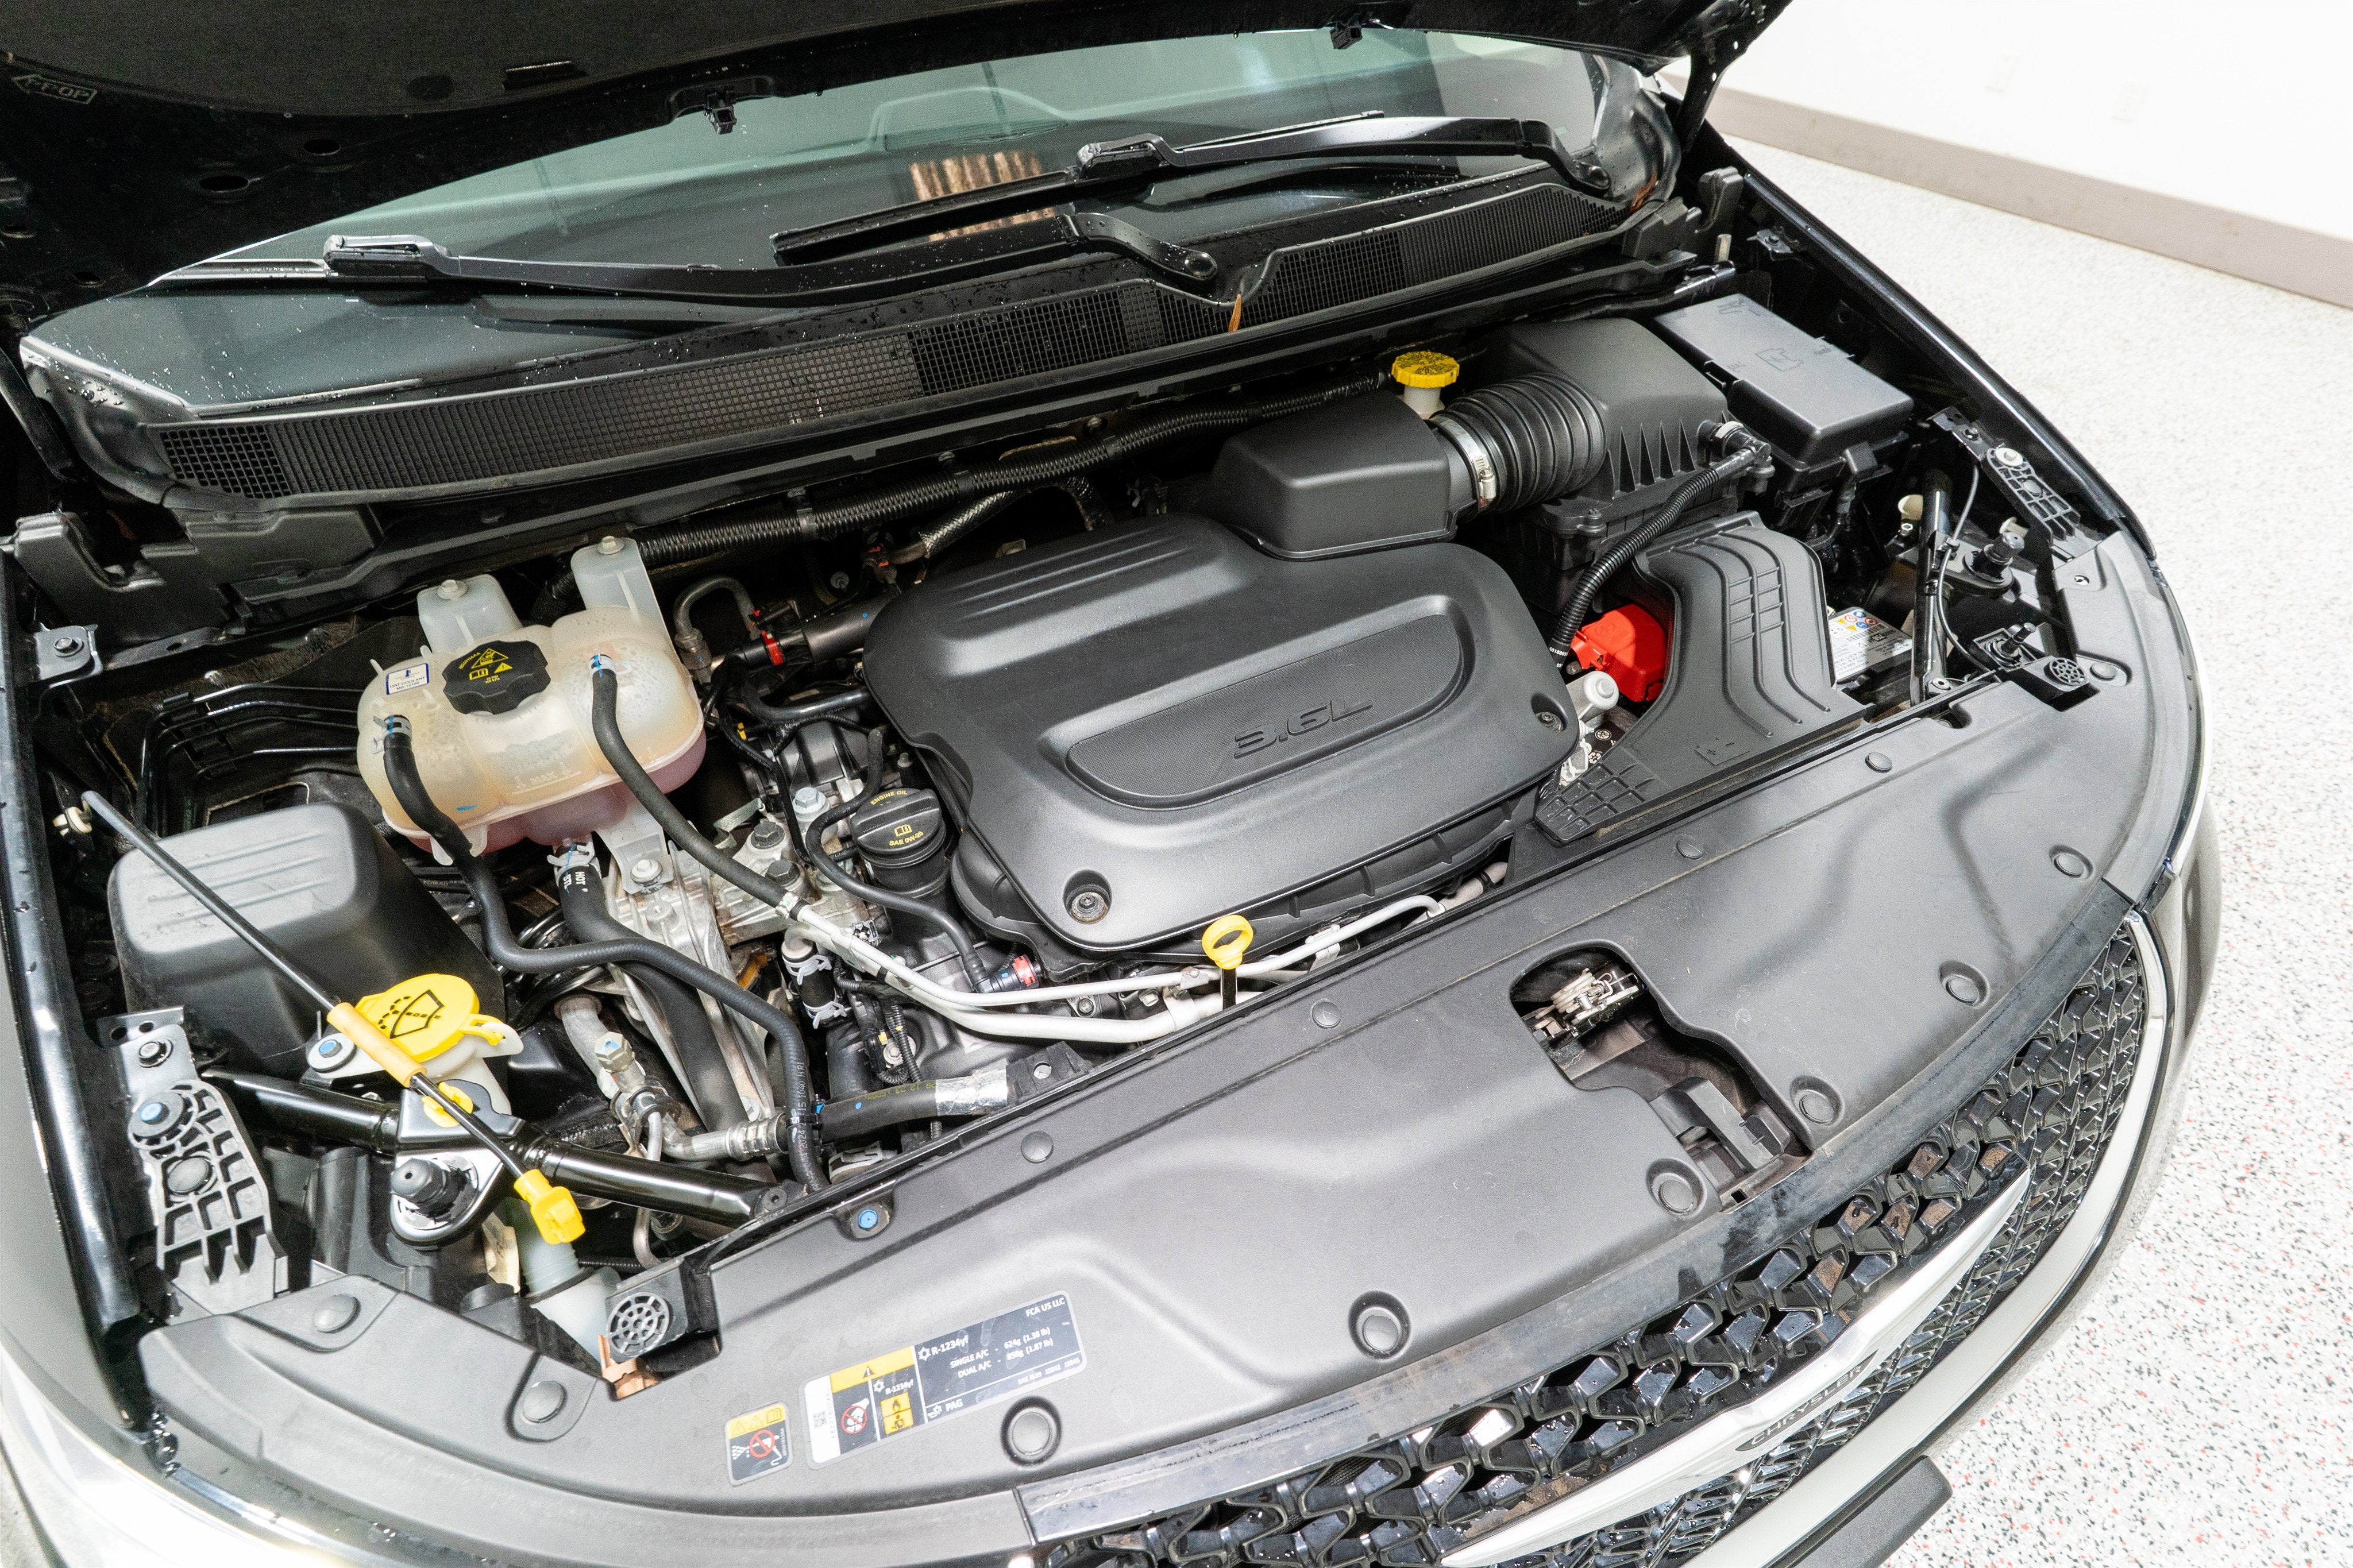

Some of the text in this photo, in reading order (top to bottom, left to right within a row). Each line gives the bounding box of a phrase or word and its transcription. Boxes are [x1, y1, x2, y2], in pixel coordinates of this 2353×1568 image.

[1233, 696, 1373, 759] 3.6L
[530, 771, 557, 785] MAX
[870, 791, 895, 805] ENGINE
[904, 831, 924, 844] 0W-20
[575, 871, 586, 885] HOT
[1025, 1297, 1065, 1317] FCA US LLC
[931, 1334, 969, 1355] R-1234yf
[950, 1354, 975, 1369] SINGLE
[975, 1349, 989, 1360] A/C
[1004, 1338, 1021, 1350] 624g
[1041, 1326, 1051, 1337] lb)
[958, 1365, 978, 1378] DUAL
[978, 1360, 992, 1372] A/C
[1044, 1338, 1054, 1348] lb)
[885, 1378, 914, 1395] R-1234yf
[1017, 1376, 1029, 1385] SAE
[945, 1398, 963, 1412] PAG
